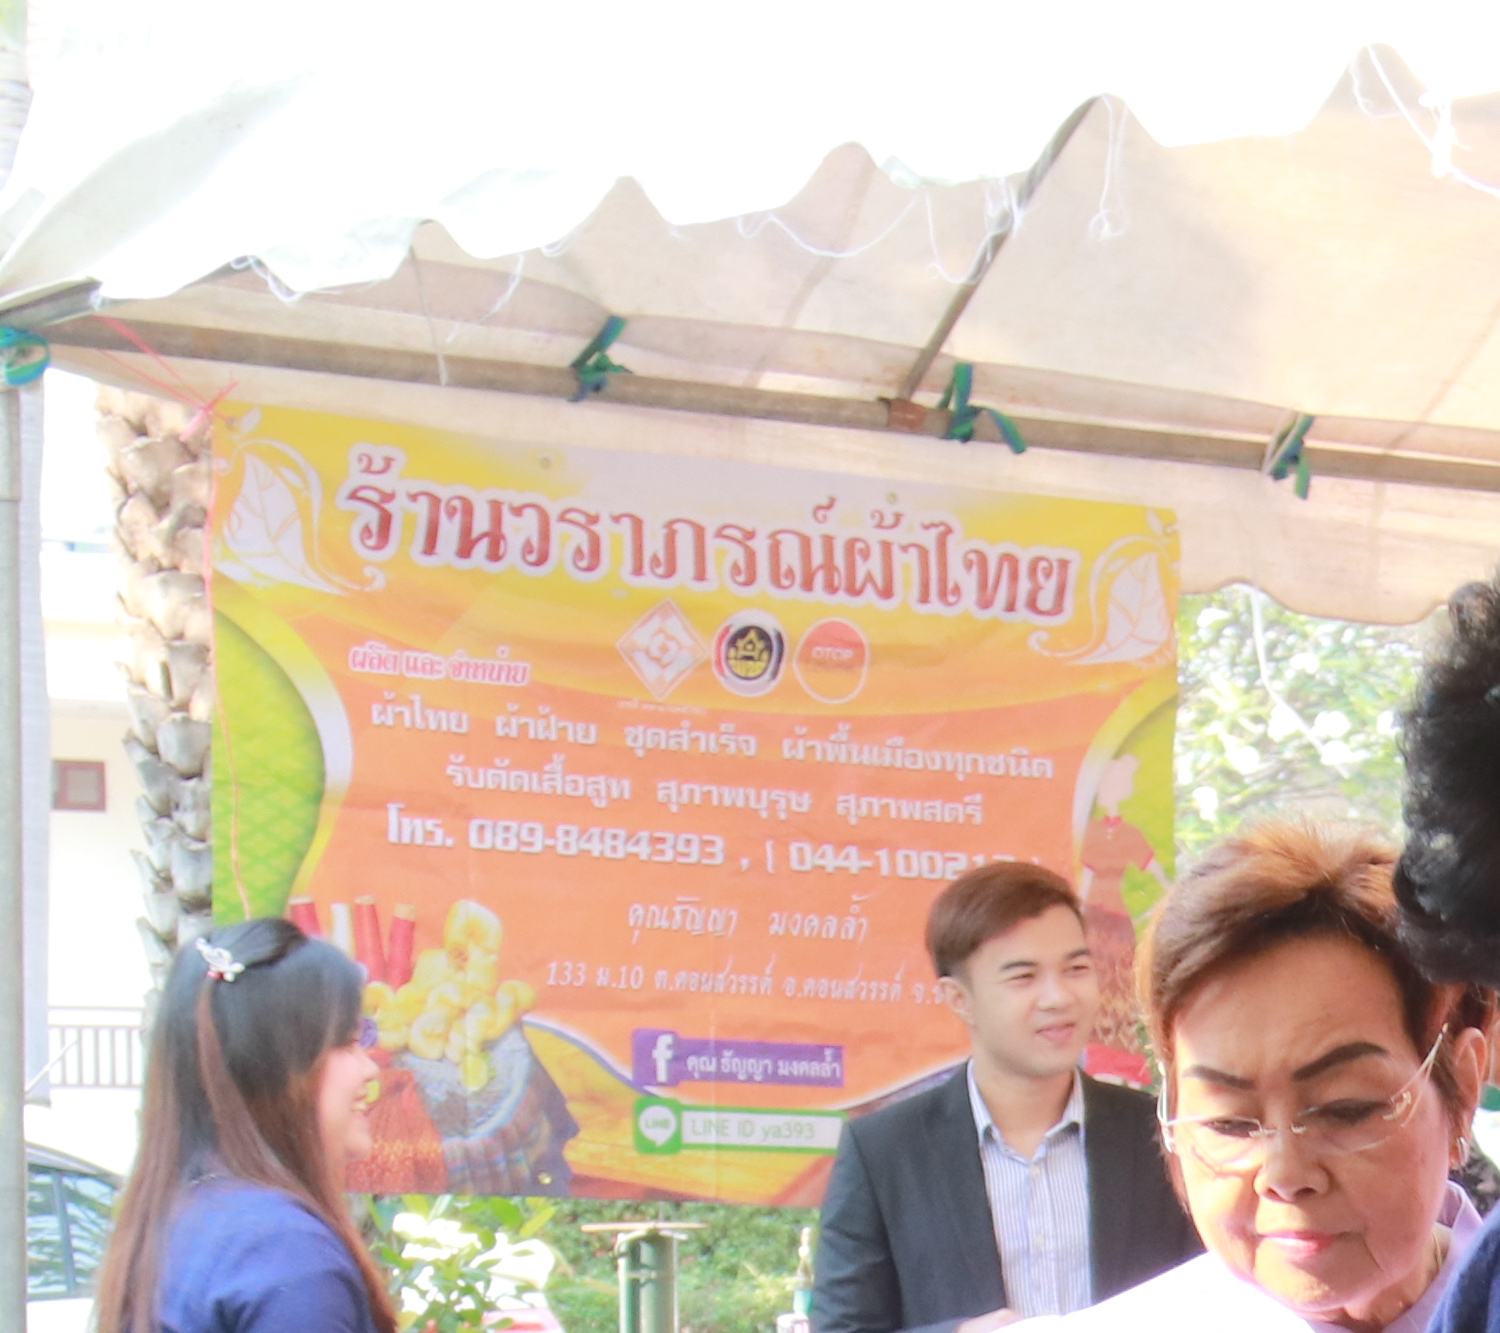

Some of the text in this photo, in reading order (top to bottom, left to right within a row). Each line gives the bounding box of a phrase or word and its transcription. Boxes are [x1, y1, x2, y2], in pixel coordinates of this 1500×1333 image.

[346, 452, 1071, 617] ร้านวราภรณ์ผ้าไทย
[350, 640, 531, 686] ผลิต และ จำหน่าย
[811, 644, 853, 662] OTOP
[371, 692, 469, 735] ผ้าไทย
[495, 703, 598, 745] ผ้าฝ้าย
[624, 719, 758, 757] ชุดสำเร็จ
[782, 723, 1055, 781] ผ้าพื้นเมืองทุกชนิด
[445, 754, 983, 826] รับตัดเสื้อสูท สุภาพบุรุษ สุภาพสตรี
[386, 803, 454, 848] โทร.
[468, 818, 725, 866] 089-8484393
[789, 840, 1017, 881] 044-1002
[546, 962, 586, 987] 133
[596, 964, 644, 990] ม.10
[686, 1054, 717, 1079] คุณ
[720, 1050, 773, 1081] ธัญญา
[777, 1048, 841, 1079] มงคลล้ำ
[691, 1118, 816, 1142] LINE ID ya393
